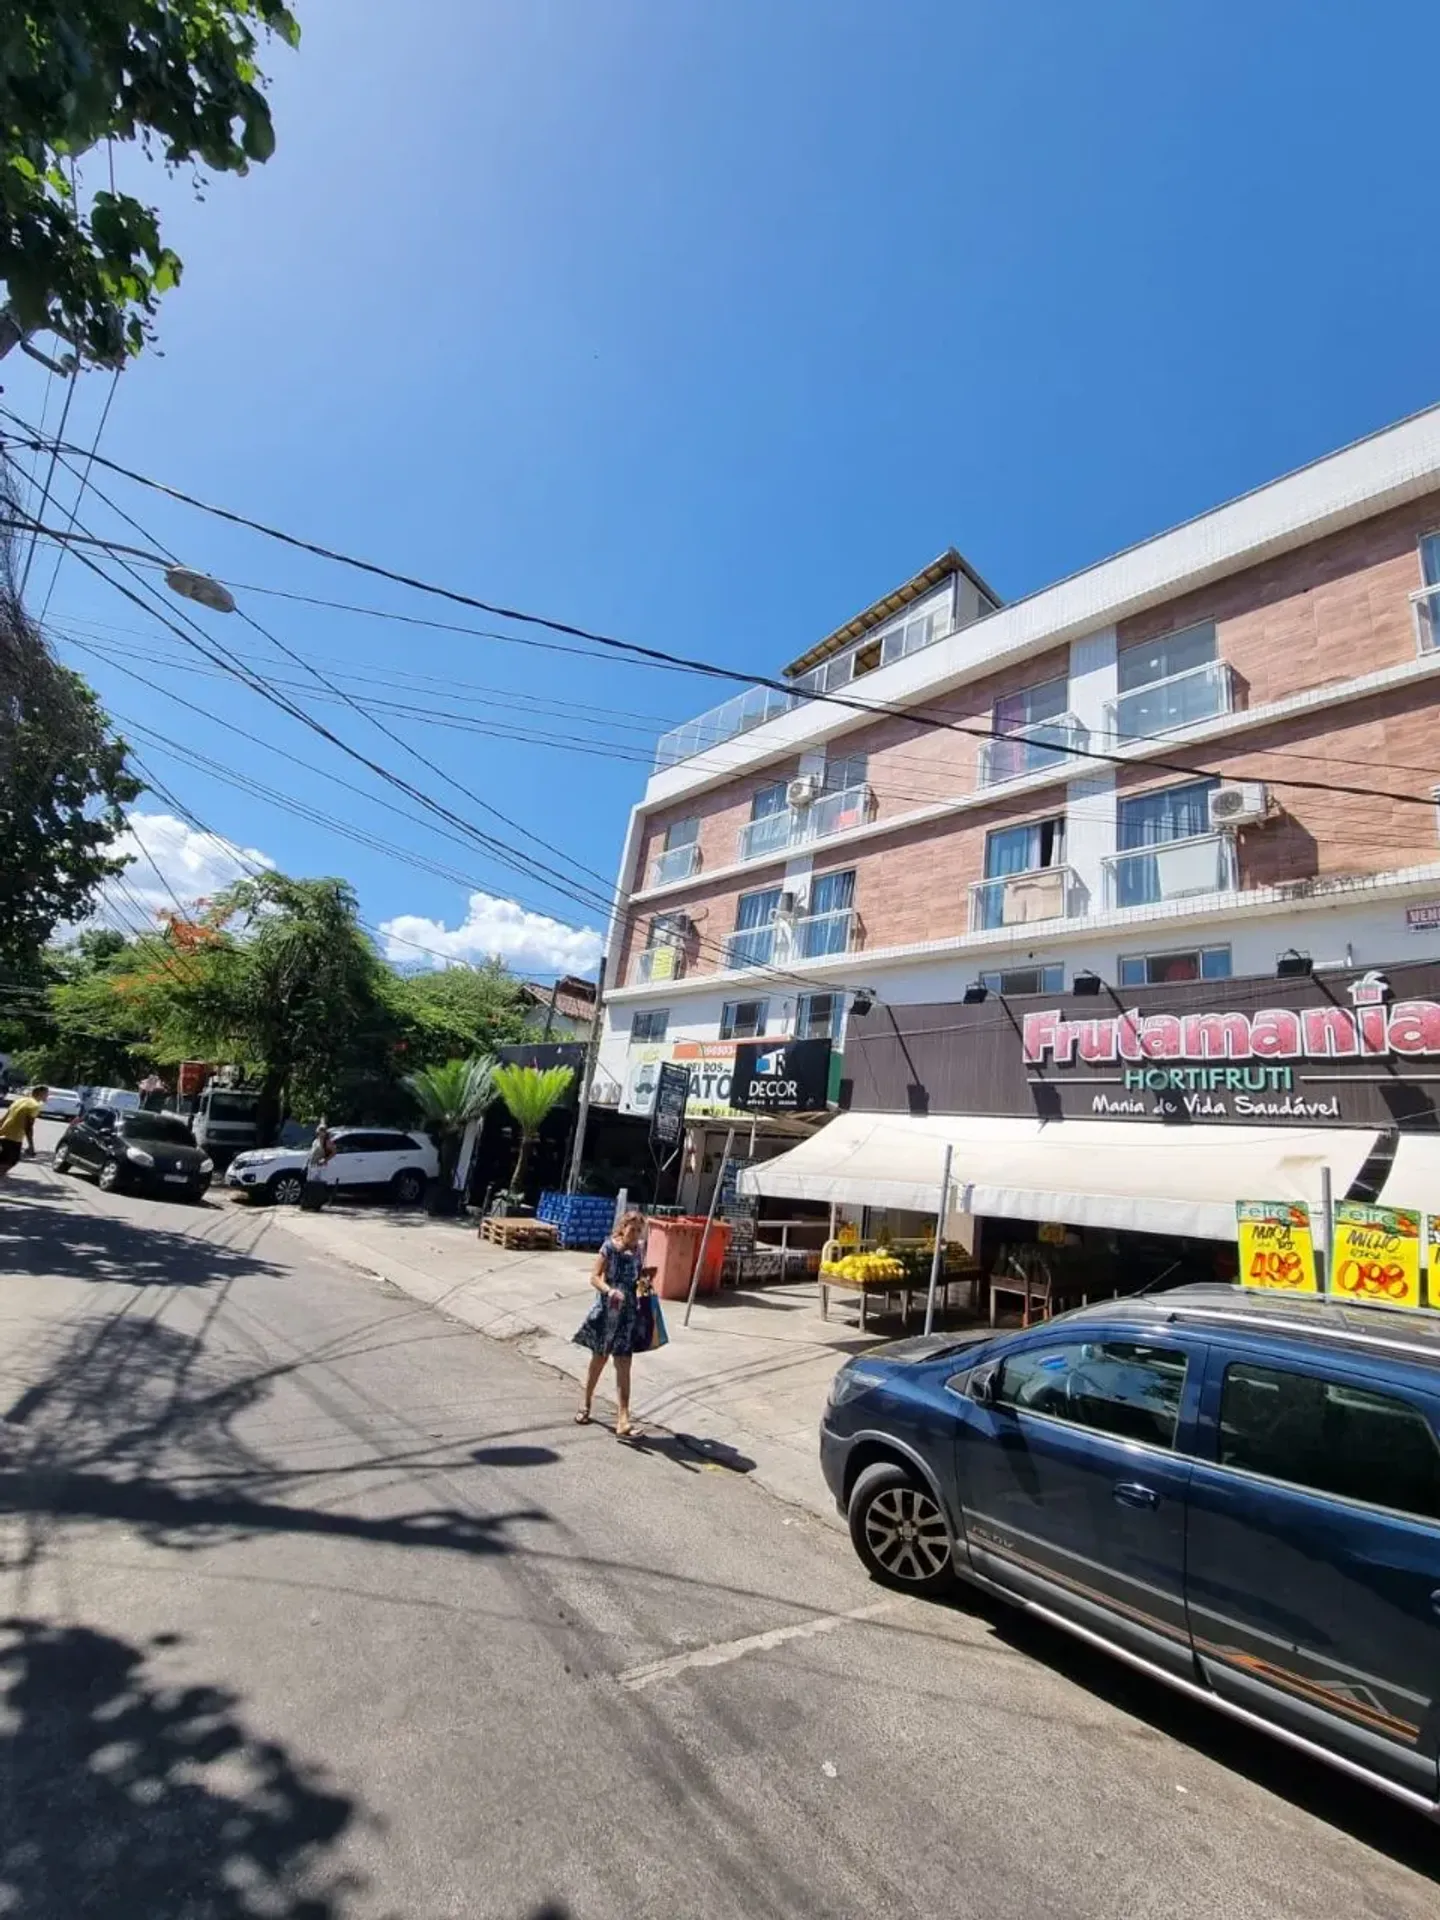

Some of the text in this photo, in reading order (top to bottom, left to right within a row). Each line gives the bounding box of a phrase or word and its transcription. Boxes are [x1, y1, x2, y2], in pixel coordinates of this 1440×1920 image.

[1022, 1000, 1440, 1064] Frutamania
[749, 1081, 797, 1098] DECOR
[1124, 1067, 1292, 1092] HORTIFRUTI
[1092, 1094, 1339, 1117] Mania de Vida Saudável
